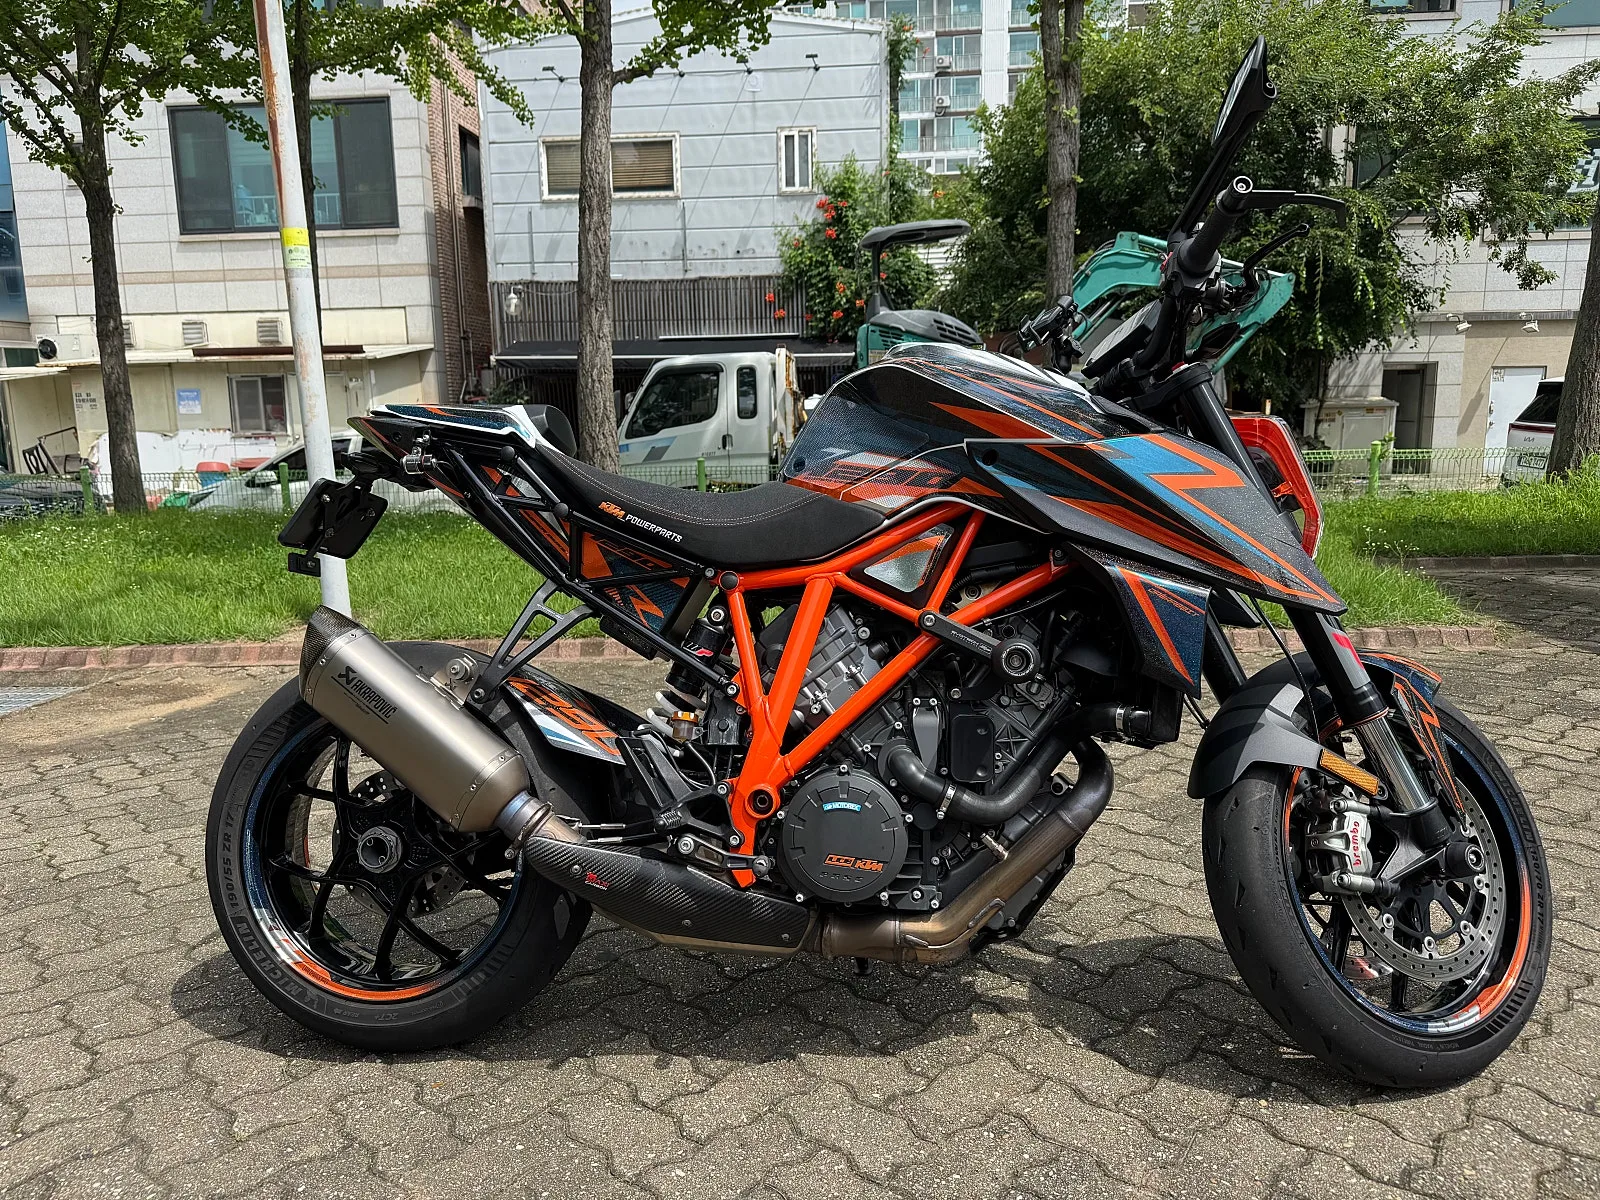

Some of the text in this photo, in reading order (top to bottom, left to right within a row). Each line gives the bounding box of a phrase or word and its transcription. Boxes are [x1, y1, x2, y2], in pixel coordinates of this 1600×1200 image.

[625, 513, 683, 543] POWERPARTS
[350, 679, 399, 719] AKRAPOVIČ
[222, 834, 232, 853] ZR
[1349, 820, 1362, 867] brembo
[221, 857, 240, 909] 190/55
[1530, 849, 1543, 890] 120/70
[236, 921, 303, 997] MICHELIN
